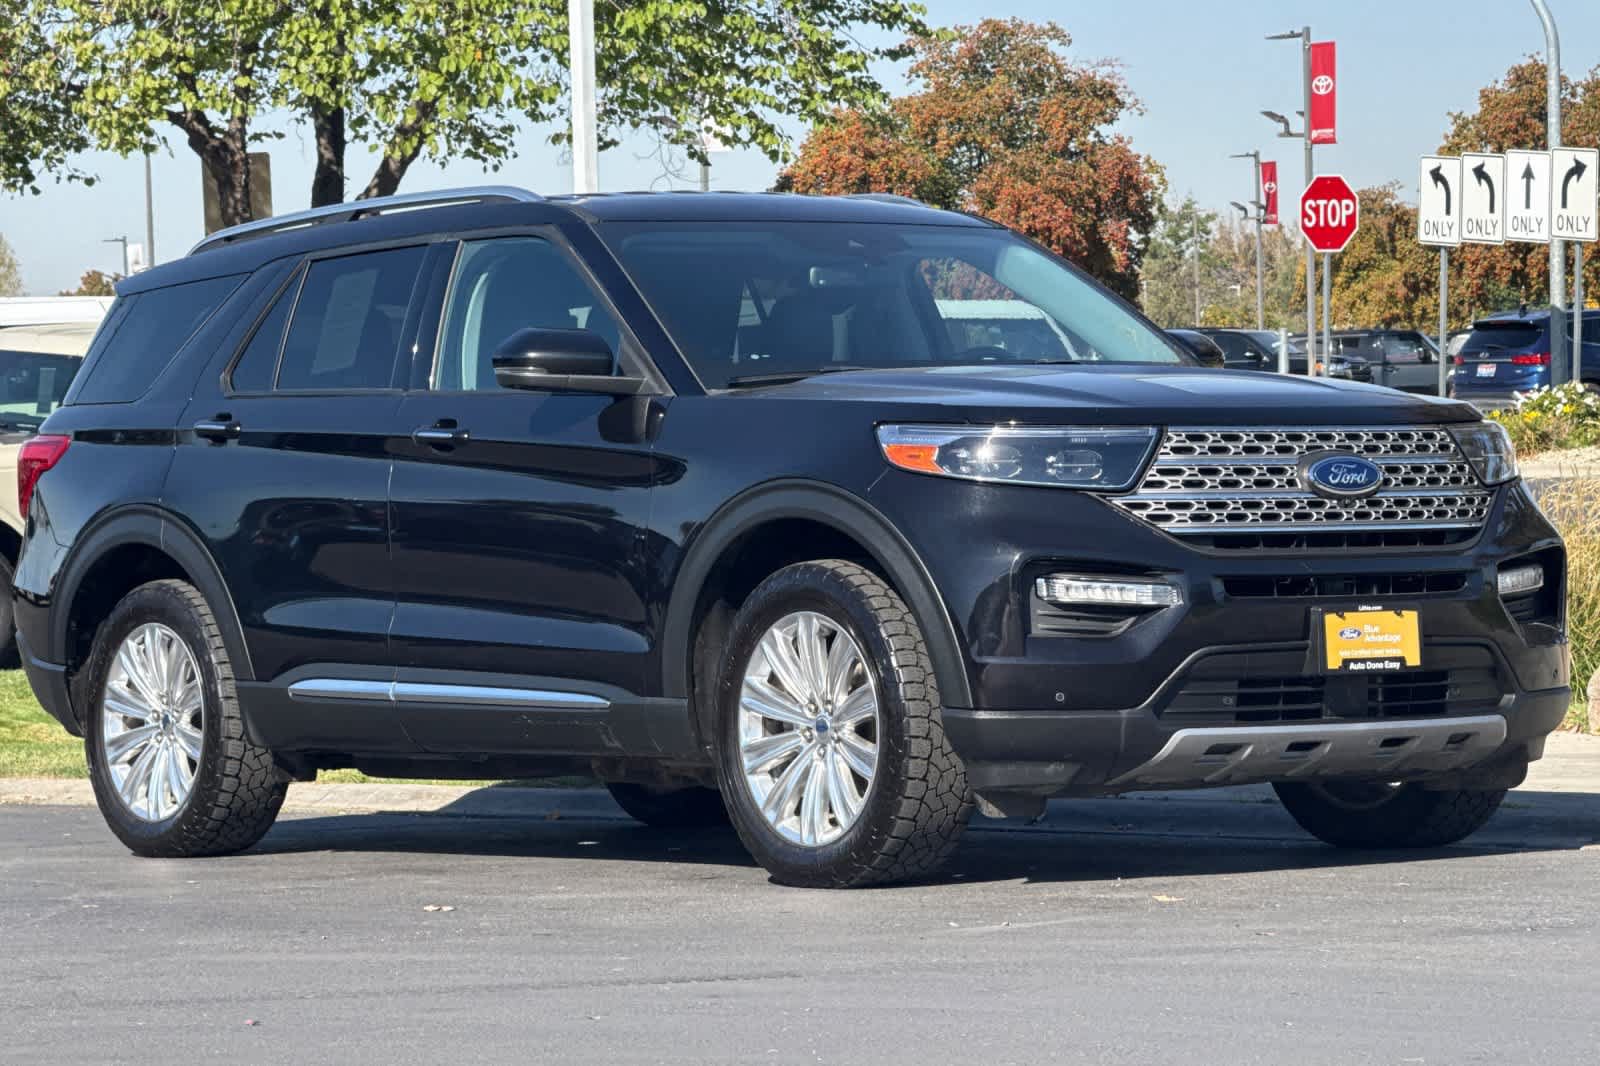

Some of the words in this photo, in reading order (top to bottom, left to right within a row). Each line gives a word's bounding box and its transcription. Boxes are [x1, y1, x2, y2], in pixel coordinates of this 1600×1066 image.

[1304, 199, 1354, 228] STOP
[1424, 220, 1454, 238] ONLY
[1466, 218, 1498, 237] ONLY
[1512, 215, 1543, 234] ONLY
[1556, 214, 1590, 233] ONLY
[1328, 463, 1368, 484] Ford
[1349, 662, 1365, 670] Auto
[1366, 661, 1384, 670] Done
[1384, 660, 1401, 670] Easy
